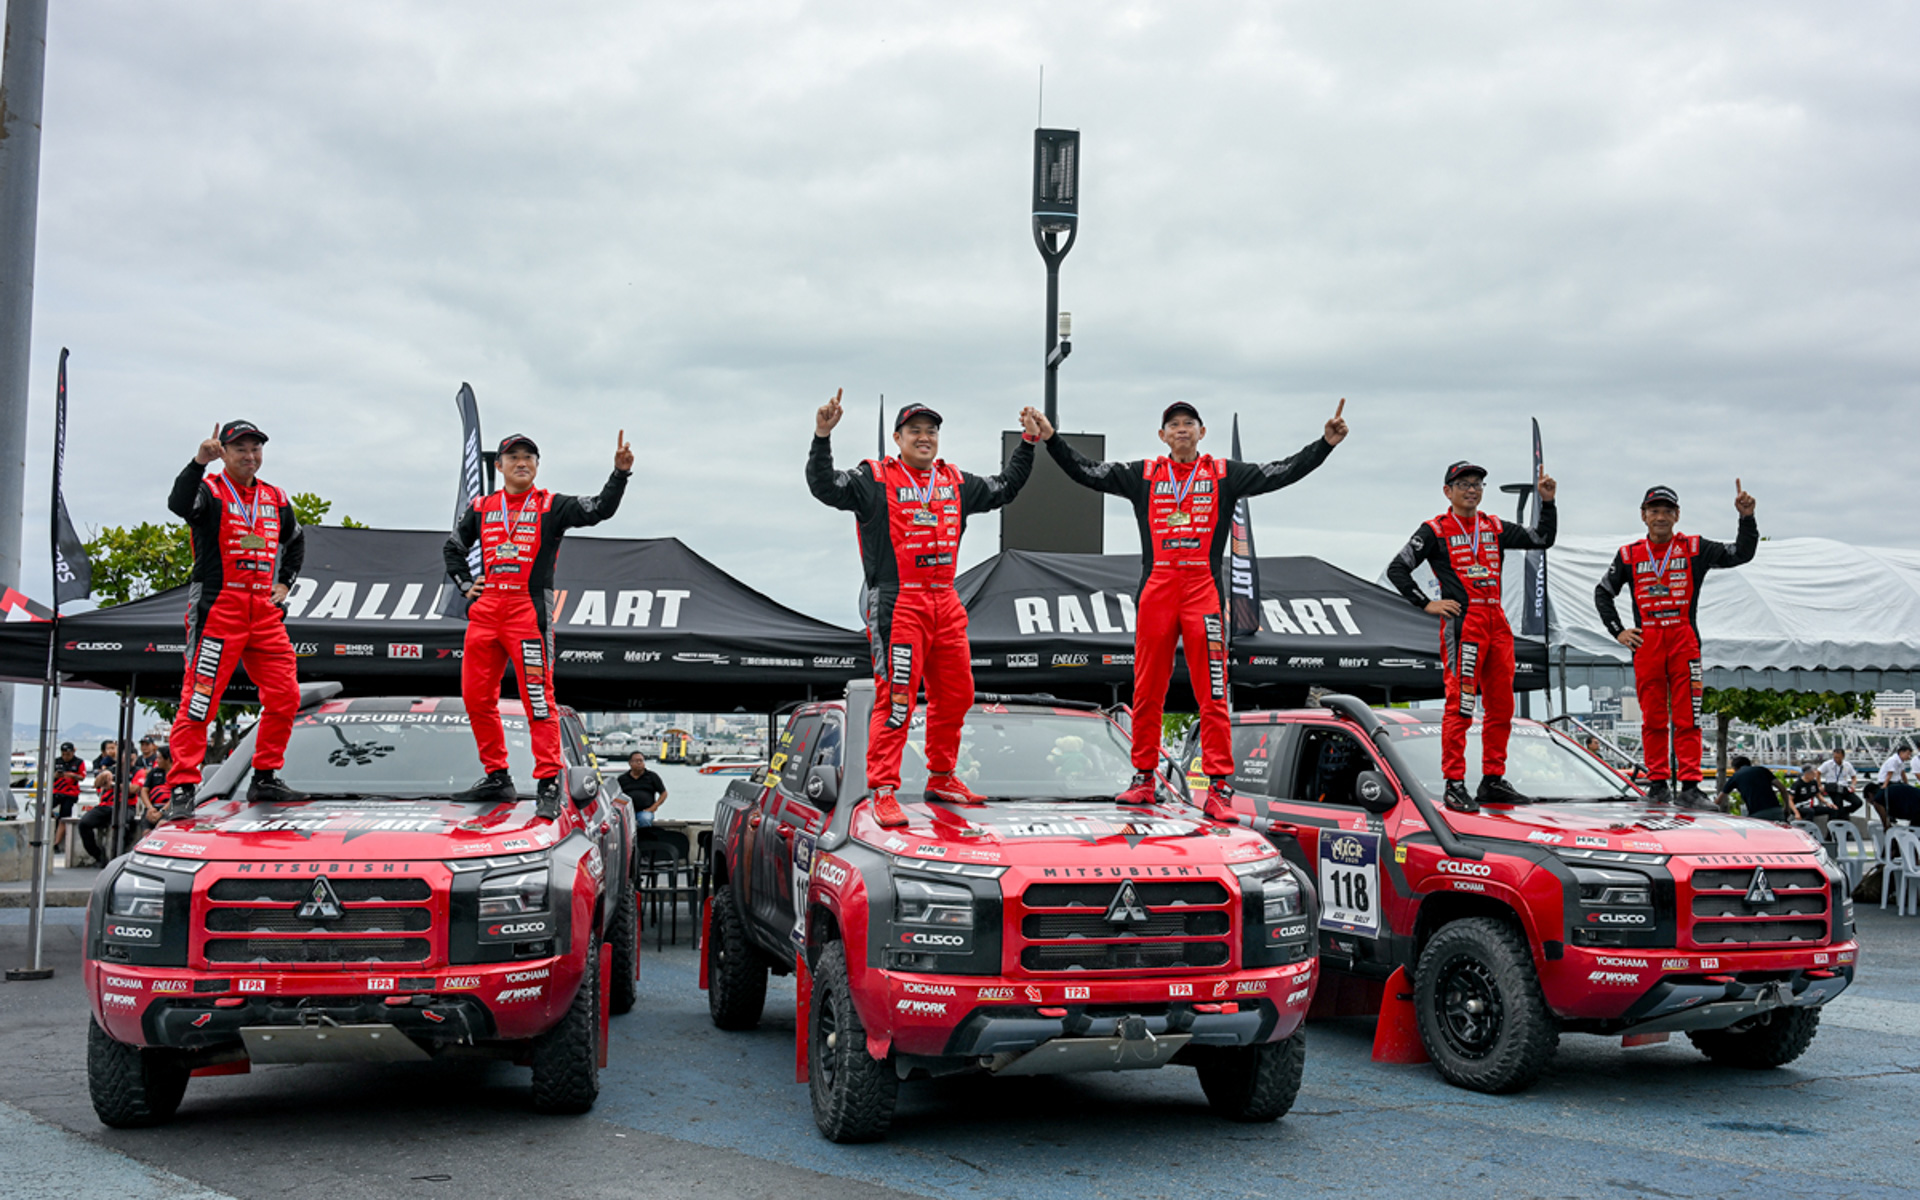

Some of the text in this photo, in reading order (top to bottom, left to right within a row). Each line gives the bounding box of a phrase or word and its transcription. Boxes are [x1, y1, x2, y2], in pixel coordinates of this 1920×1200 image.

[391, 644, 420, 657] TPR
[323, 713, 437, 724] MITSUBISHI
[1575, 836, 1608, 845] HKS
[1697, 855, 1806, 865] MITSUBISHI
[237, 862, 411, 873] MITSUBISHI
[1043, 866, 1203, 877] MITSUBISHI
[1447, 861, 1491, 876] CUSCO
[1330, 869, 1370, 913] 118
[1599, 913, 1646, 924] CUSCO
[114, 925, 153, 939] CUSCO
[500, 921, 546, 935] CUSCO
[912, 933, 964, 946] CUSCO
[1596, 956, 1648, 968] YOKOHAMA
[505, 968, 550, 984] YOKOHAMA
[106, 976, 144, 990] YOKOHAMA
[151, 979, 189, 991] ENDLESS
[240, 980, 264, 991] TPR
[369, 979, 393, 990] TPR
[443, 976, 481, 989] ENDLESS
[1236, 981, 1268, 992] ENDLESS
[902, 982, 957, 997] YOKOHAMA
[976, 986, 1016, 998] ENDLESS
[1067, 988, 1089, 998] TPR
[1170, 985, 1192, 996] TPR
